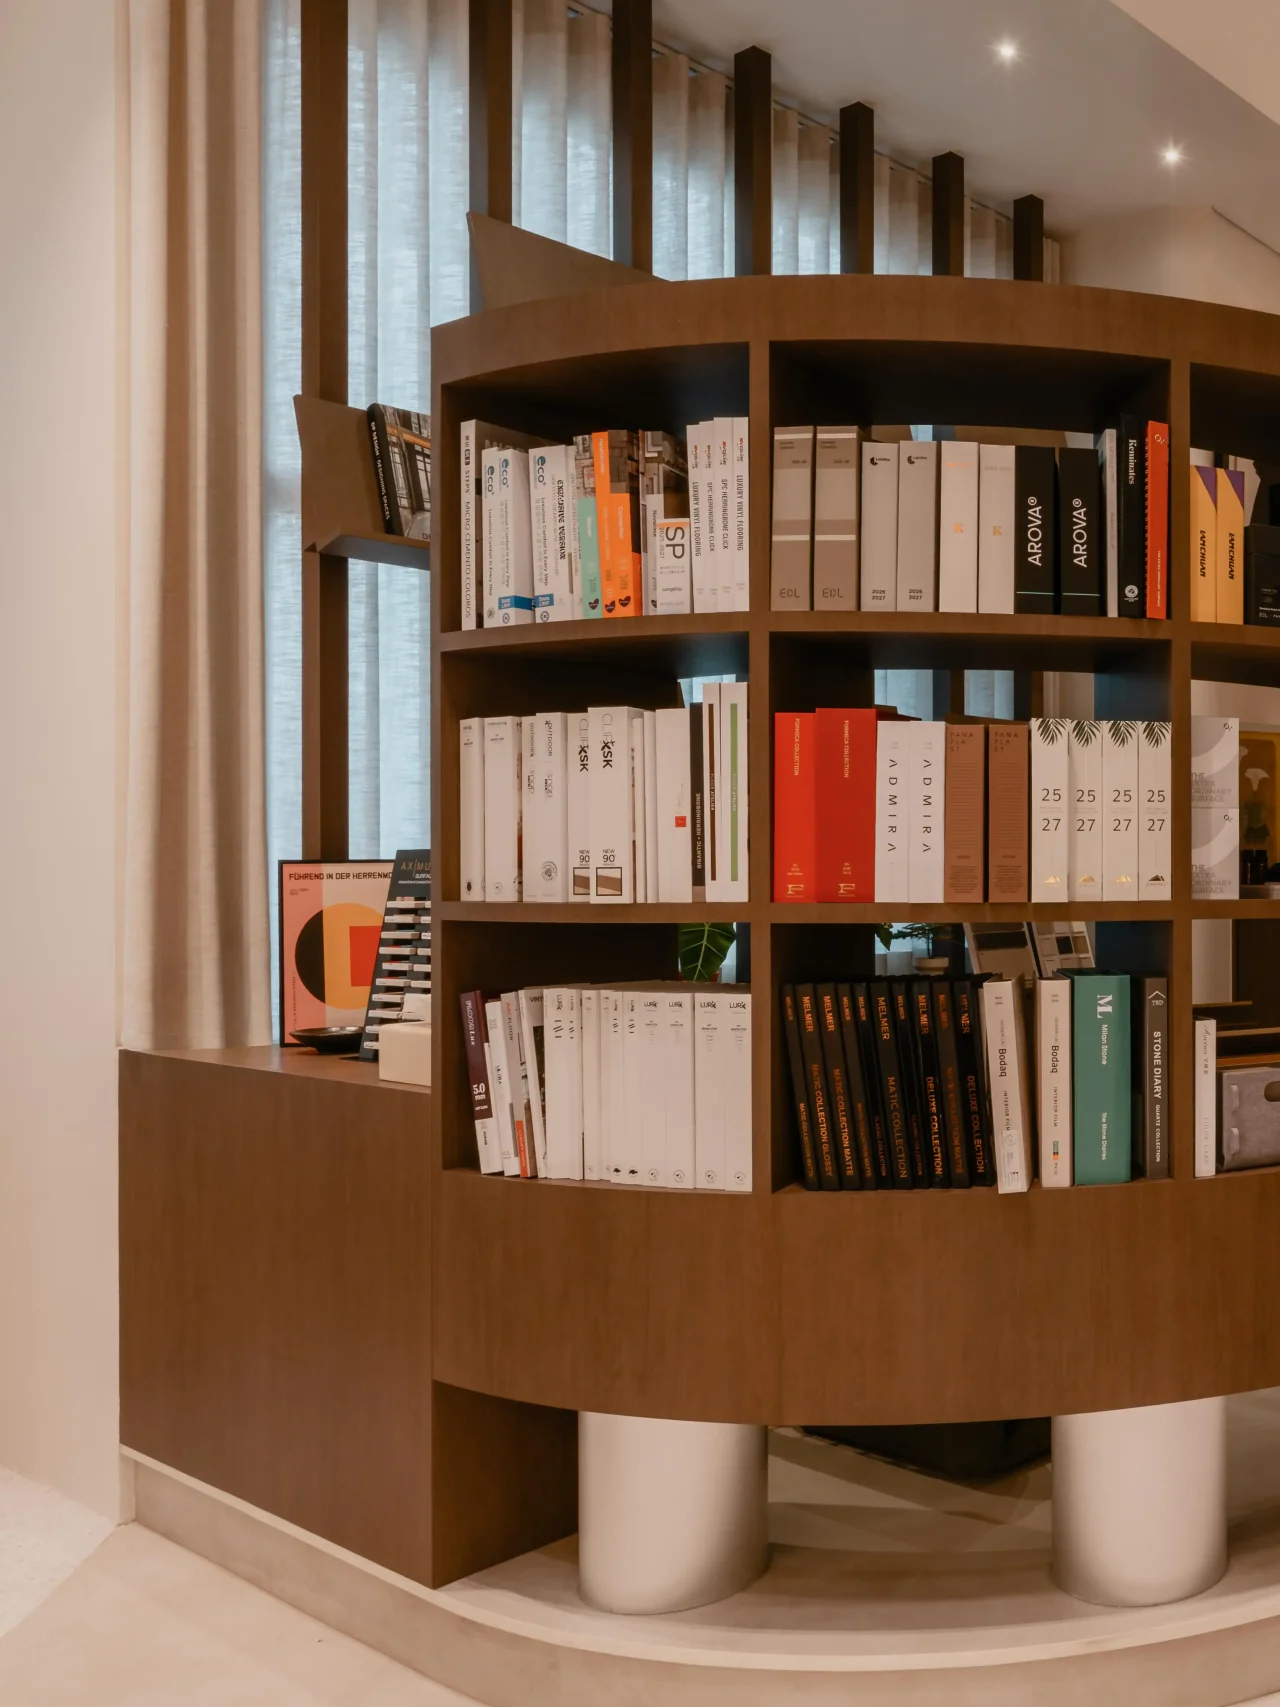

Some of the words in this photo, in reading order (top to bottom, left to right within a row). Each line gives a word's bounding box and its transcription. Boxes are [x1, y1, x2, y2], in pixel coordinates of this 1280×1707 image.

[372, 432, 380, 455] DESIGN
[377, 460, 385, 494] DESIGNING
[1128, 439, 1137, 484] Keminates
[665, 527, 685, 559] SP
[1042, 788, 1061, 801] 25
[1076, 790, 1096, 802] 25
[1113, 790, 1132, 802] 25
[1147, 790, 1165, 802] 25
[1042, 818, 1061, 831] 27
[1077, 819, 1096, 831] 27
[1113, 819, 1132, 831] 27
[1147, 819, 1165, 831] 27
[289, 872, 324, 880] FÜHREND
[802, 996, 813, 1032] MELMER
[823, 996, 835, 1032] MELMER
[858, 997, 866, 1020] MELMER
[877, 997, 889, 1040] MELMER
[918, 995, 928, 1034] MELMER
[998, 1048, 1007, 1077] Bodaq
[1050, 1045, 1059, 1073] Bodaq
[1153, 1031, 1161, 1065] STONE
[812, 1065, 820, 1089] MATIC
[833, 1069, 843, 1094] MATIC
[1153, 1068, 1161, 1099] DIARY
[888, 1077, 899, 1110] MATIC
[926, 1077, 936, 1113] DELUXE
[967, 1076, 978, 1112] DELUXE
[815, 1091, 828, 1142] COLLECTION
[836, 1095, 849, 1147] COLLECTION
[822, 1144, 833, 1176] GLOSSY
[877, 1140, 886, 1176] COLLECTION
[892, 1112, 907, 1178] COLLECTION
[930, 1115, 942, 1174] COLLECTION
[971, 1115, 984, 1173] COLLECTION
[844, 1148, 853, 1176] MATTE
